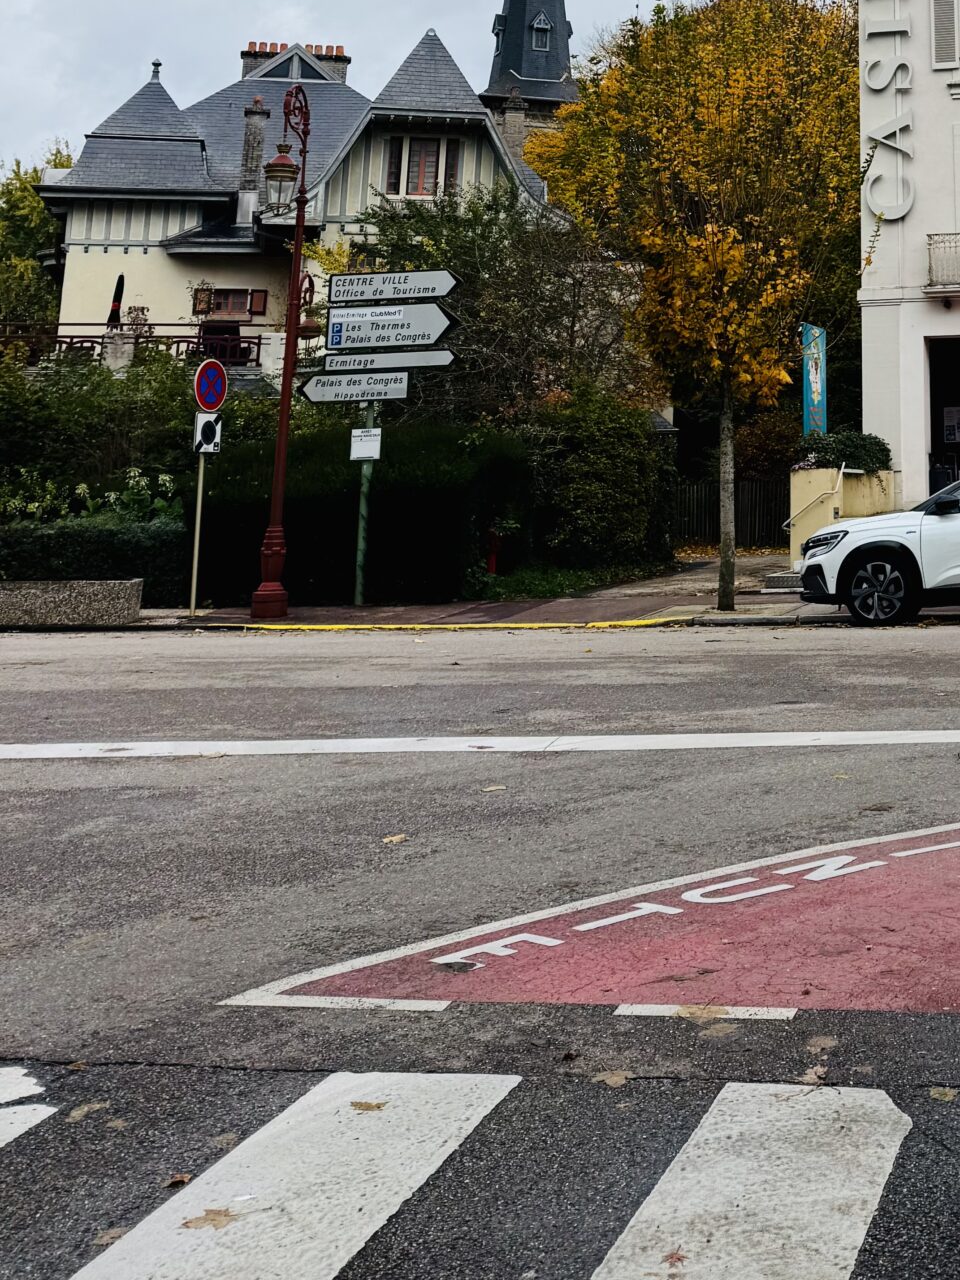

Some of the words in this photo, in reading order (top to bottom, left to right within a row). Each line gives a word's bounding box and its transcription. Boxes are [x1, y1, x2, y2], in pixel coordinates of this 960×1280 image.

[335, 277, 375, 287] CENTRE
[382, 275, 410, 285] VILLE
[334, 288, 365, 298] Office
[372, 287, 384, 296] de
[392, 285, 437, 295] Tourisme
[346, 323, 362, 332] Les
[370, 322, 411, 331] Thermes
[345, 334, 371, 343] Palais
[376, 334, 391, 342] des
[394, 332, 431, 343] Congrès
[328, 358, 375, 368] Ermitage
[315, 378, 342, 387] Palais
[346, 377, 362, 386] des
[366, 375, 404, 387] Congrès
[334, 390, 388, 400] Hippodrome
